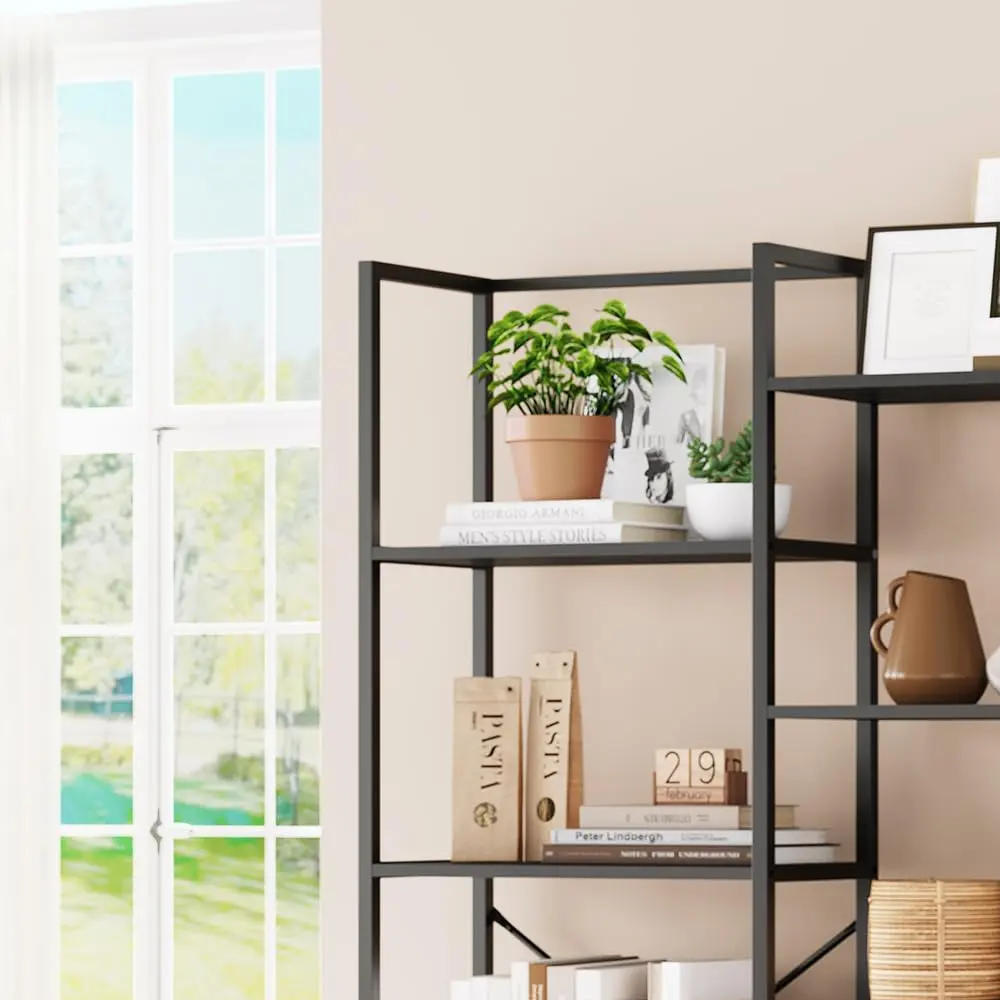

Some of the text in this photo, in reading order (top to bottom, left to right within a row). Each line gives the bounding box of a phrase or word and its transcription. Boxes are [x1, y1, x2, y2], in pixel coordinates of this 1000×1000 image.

[472, 508, 527, 521] GIORGIO
[503, 529, 546, 545] STYLE
[549, 526, 608, 543] STORIES
[575, 831, 664, 844] Peter Lindbergh
